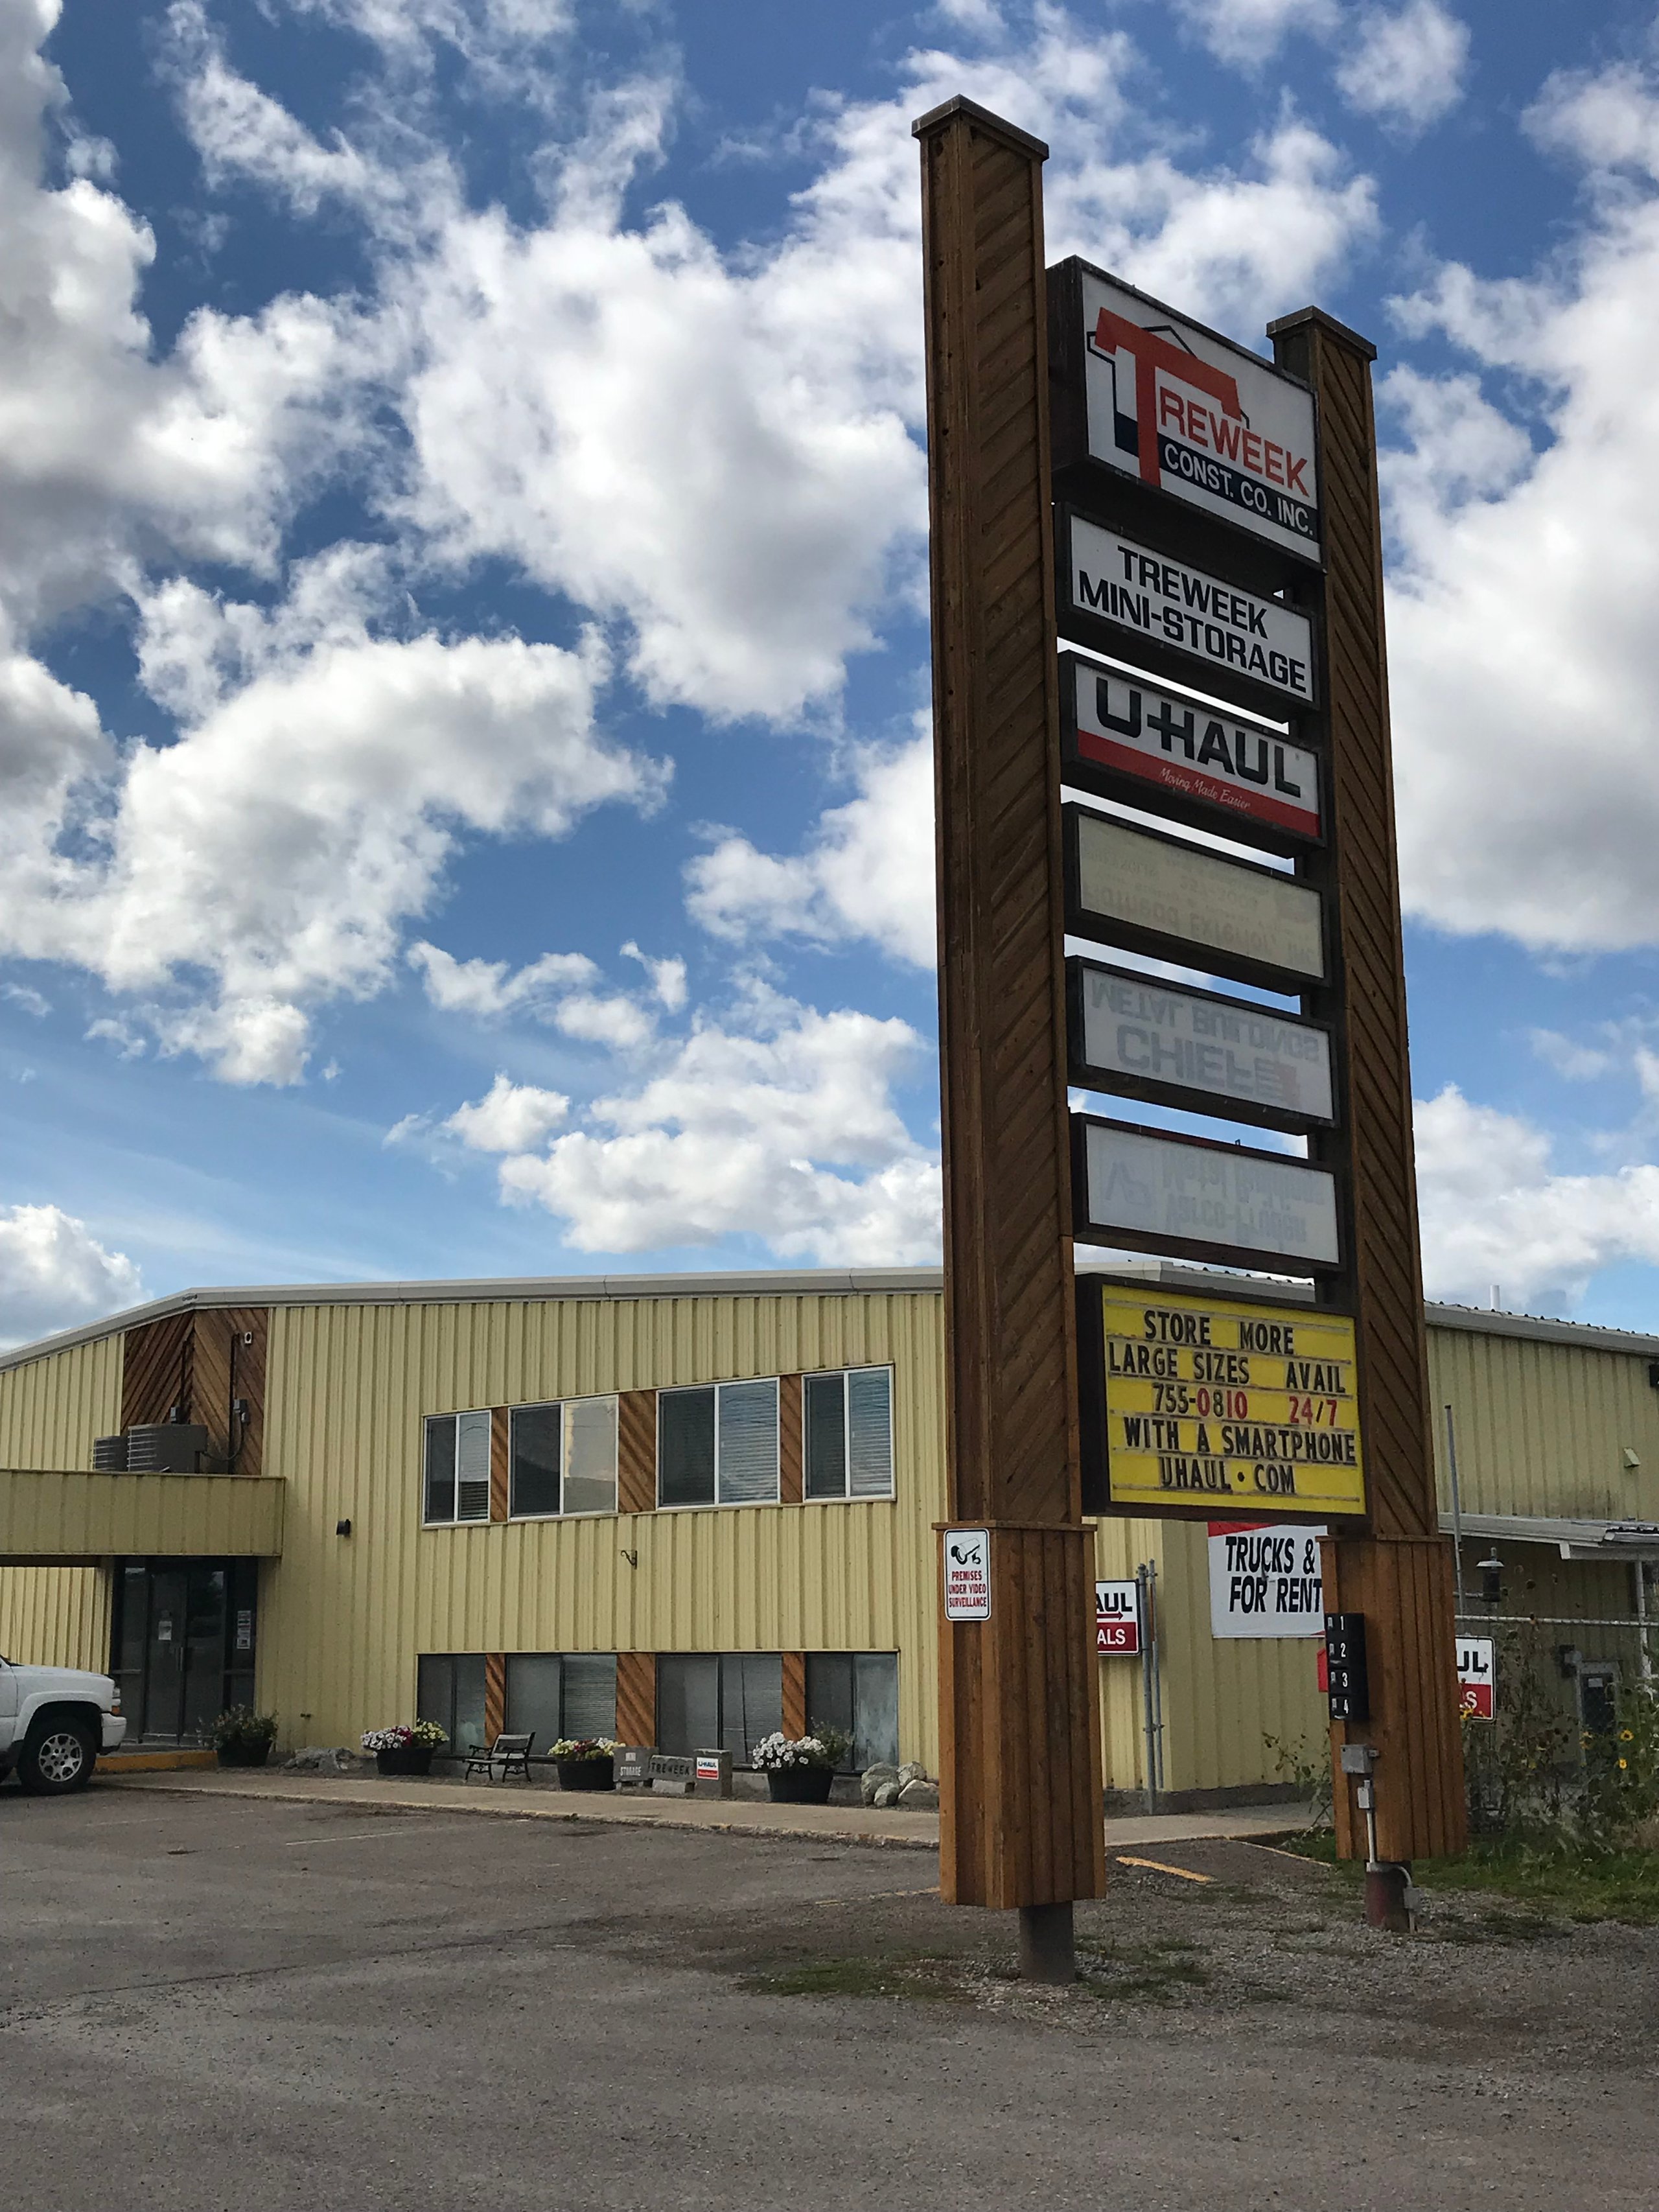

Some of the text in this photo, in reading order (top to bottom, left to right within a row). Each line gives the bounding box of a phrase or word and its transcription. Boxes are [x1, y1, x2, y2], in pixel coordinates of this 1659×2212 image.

[1165, 443, 1314, 535] CONST. CO. INC.
[1117, 545, 1268, 640] TREWEEK
[1079, 570, 1306, 693] MINI-STORAGE
[1096, 677, 1301, 798] U-HAUL
[1160, 767, 1251, 809] Moving Made Easier
[1144, 1310, 1294, 1355] STORE MORE
[1109, 1342, 1345, 1393] LARGE SIZES AVAIL
[1153, 1382, 1338, 1426] 755-0810 24/7
[1124, 1417, 1356, 1462] WITH A SMARTPHONE
[951, 1570, 982, 1581] PREMISES
[1225, 1536, 1316, 1575] TRUCKS &
[948, 1583, 986, 1594] UNDER VIDEO
[949, 1597, 987, 1607] SURVEILLANCE
[1229, 1576, 1322, 1613] FOR RENT
[1340, 1642, 1346, 1657] 2
[1342, 1672, 1348, 1687] 3
